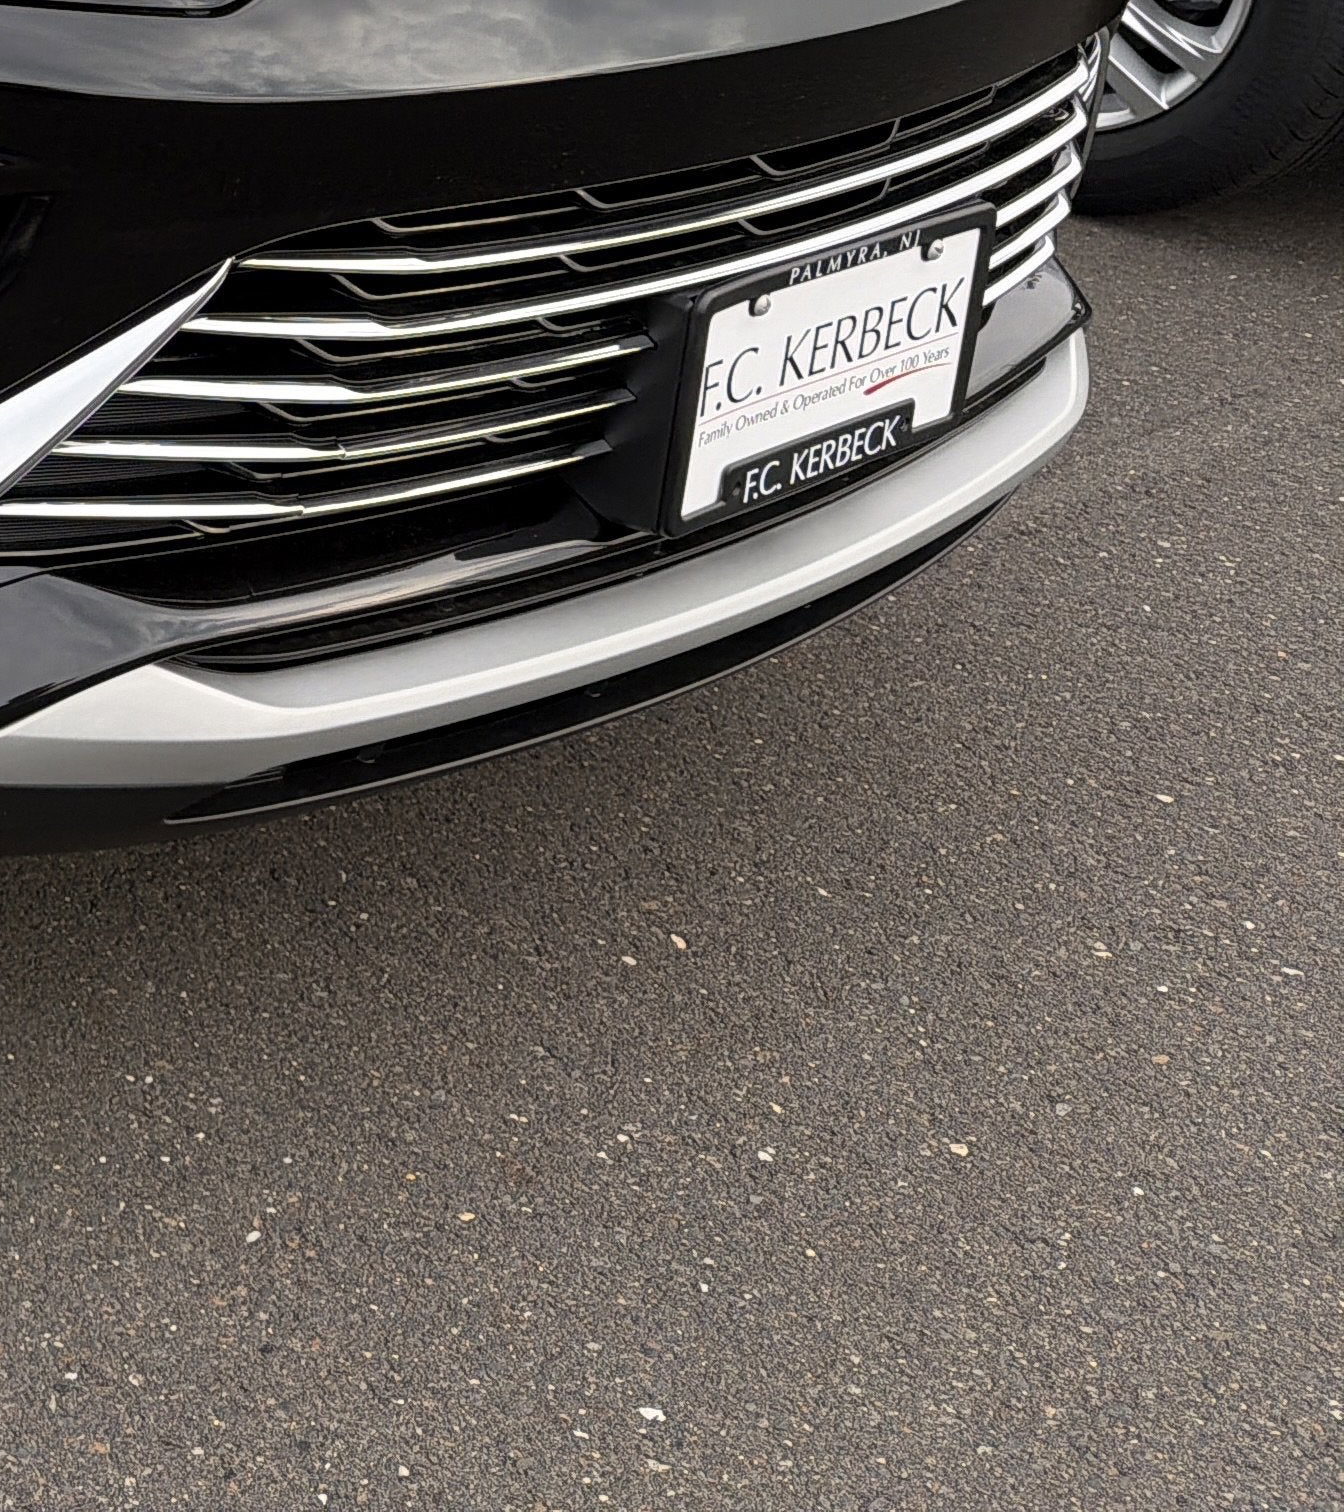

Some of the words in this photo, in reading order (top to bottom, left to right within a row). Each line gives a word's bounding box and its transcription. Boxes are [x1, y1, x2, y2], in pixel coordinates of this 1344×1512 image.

[789, 241, 889, 285] PALMYRA,
[699, 346, 763, 418] F.C.
[779, 277, 967, 387] KERBECK
[698, 421, 733, 448] Family
[735, 402, 779, 431] Owned
[780, 400, 790, 415] &
[792, 378, 847, 412] Operated
[849, 374, 868, 392] For
[869, 365, 897, 384] Over
[900, 354, 920, 373] 100
[922, 346, 950, 364] Years
[789, 415, 902, 485] KERBECK
